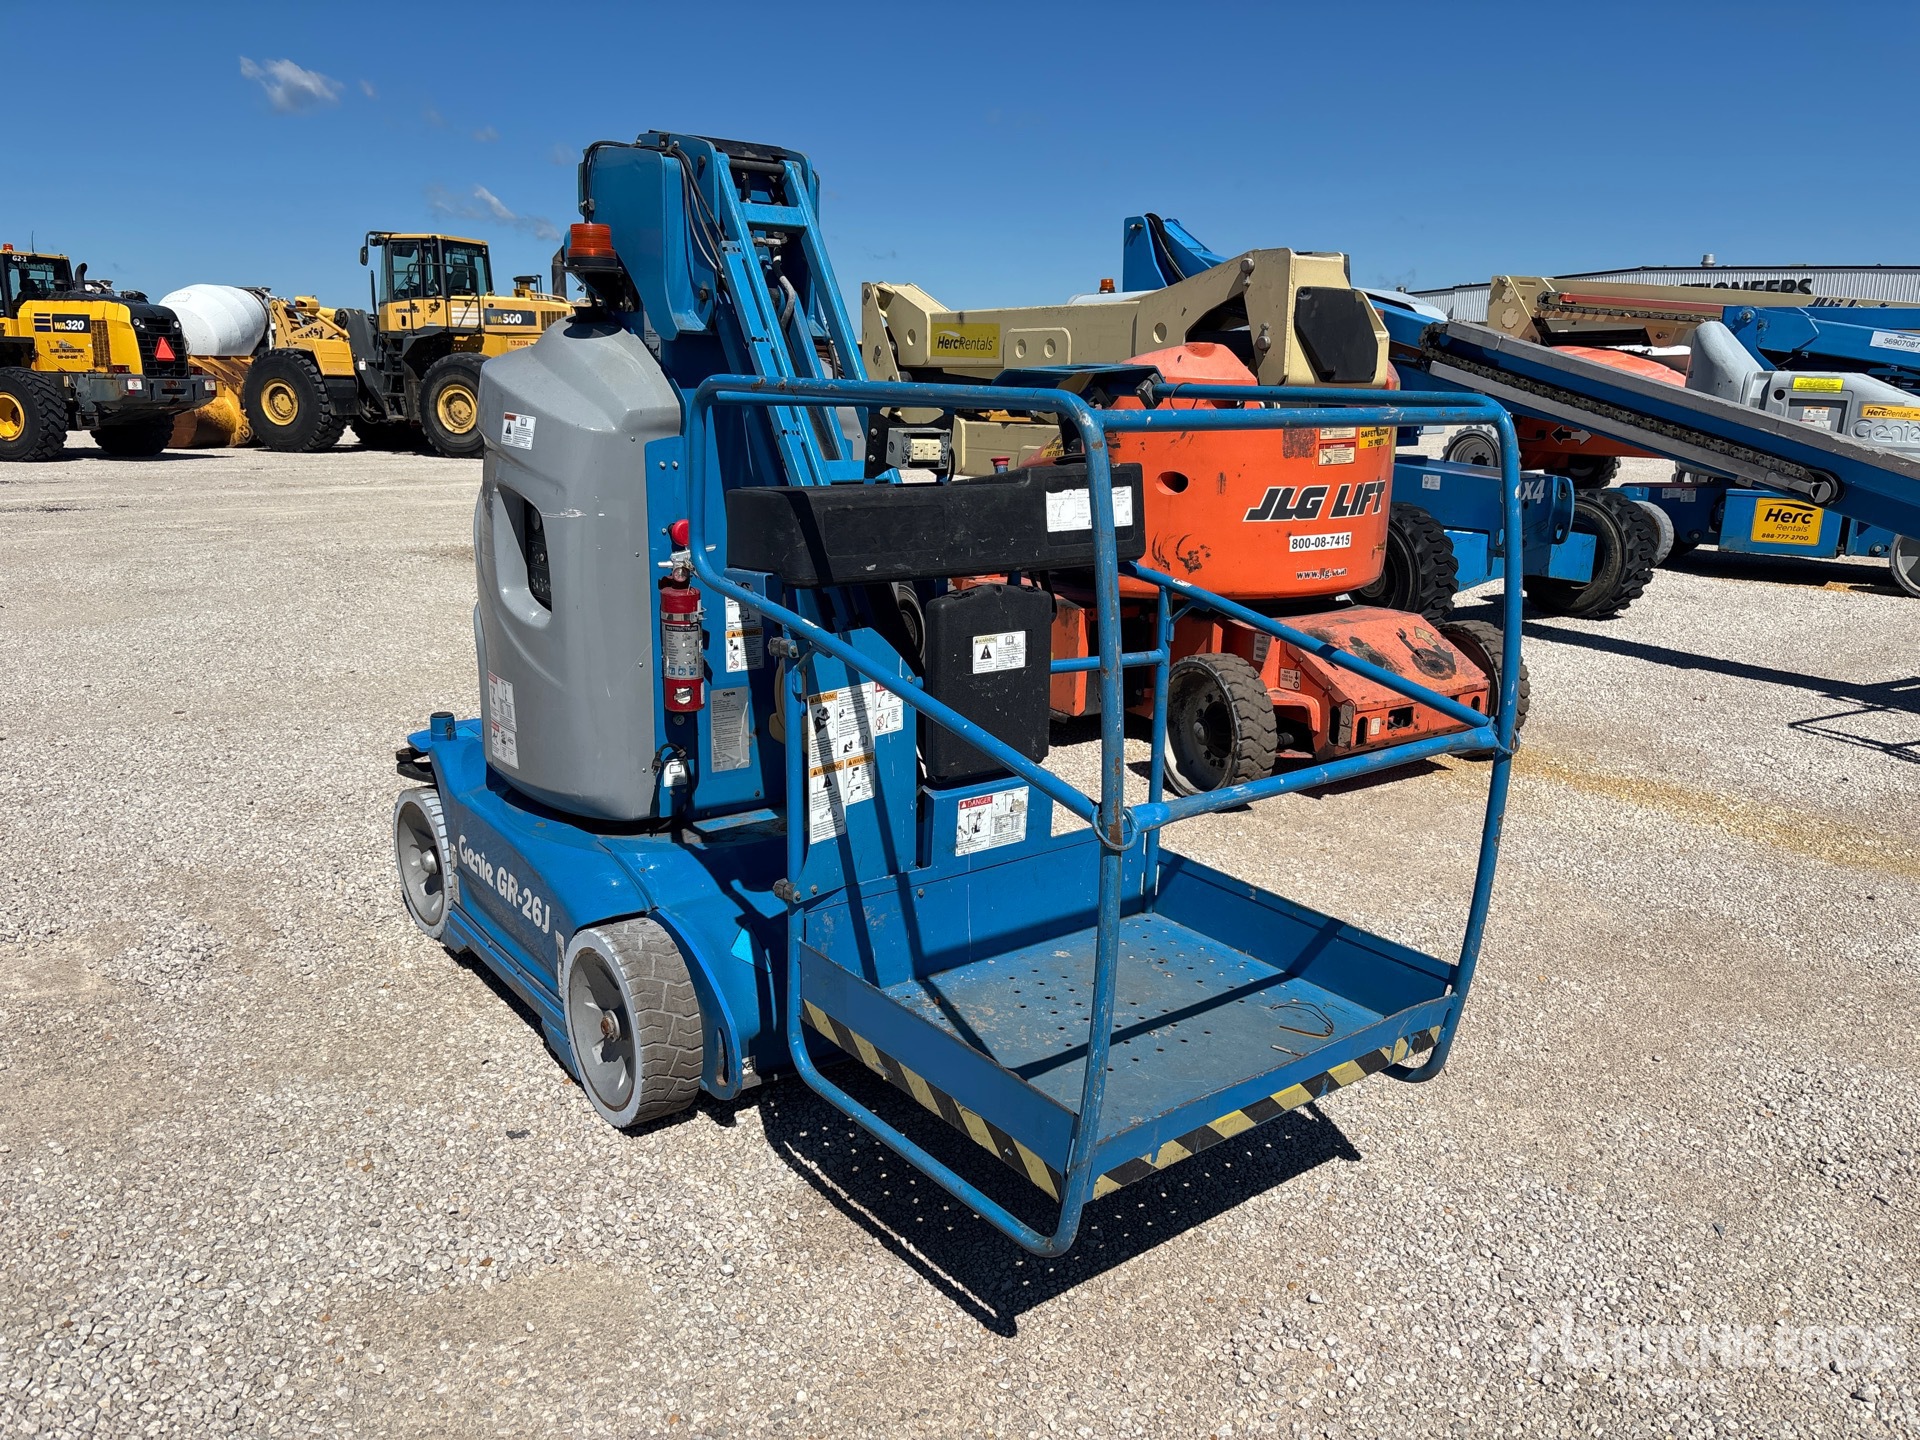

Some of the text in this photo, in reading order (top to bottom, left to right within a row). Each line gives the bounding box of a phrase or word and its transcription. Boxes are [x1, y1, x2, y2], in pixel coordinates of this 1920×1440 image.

[54, 320, 85, 331] WA320
[1361, 429, 1379, 438] SAFET
[1520, 479, 1545, 505] X4
[1243, 480, 1386, 522] JLG LIFT
[1764, 507, 1814, 524] Herc
[1776, 523, 1809, 533] Rentals
[1291, 534, 1350, 549] 800-08-7415
[1761, 532, 1809, 541] 888-777-2700
[814, 692, 837, 702] WARNING
[817, 762, 843, 774] WARNING
[967, 796, 992, 808] DANGER
[458, 834, 550, 934] Genie GR-26J
